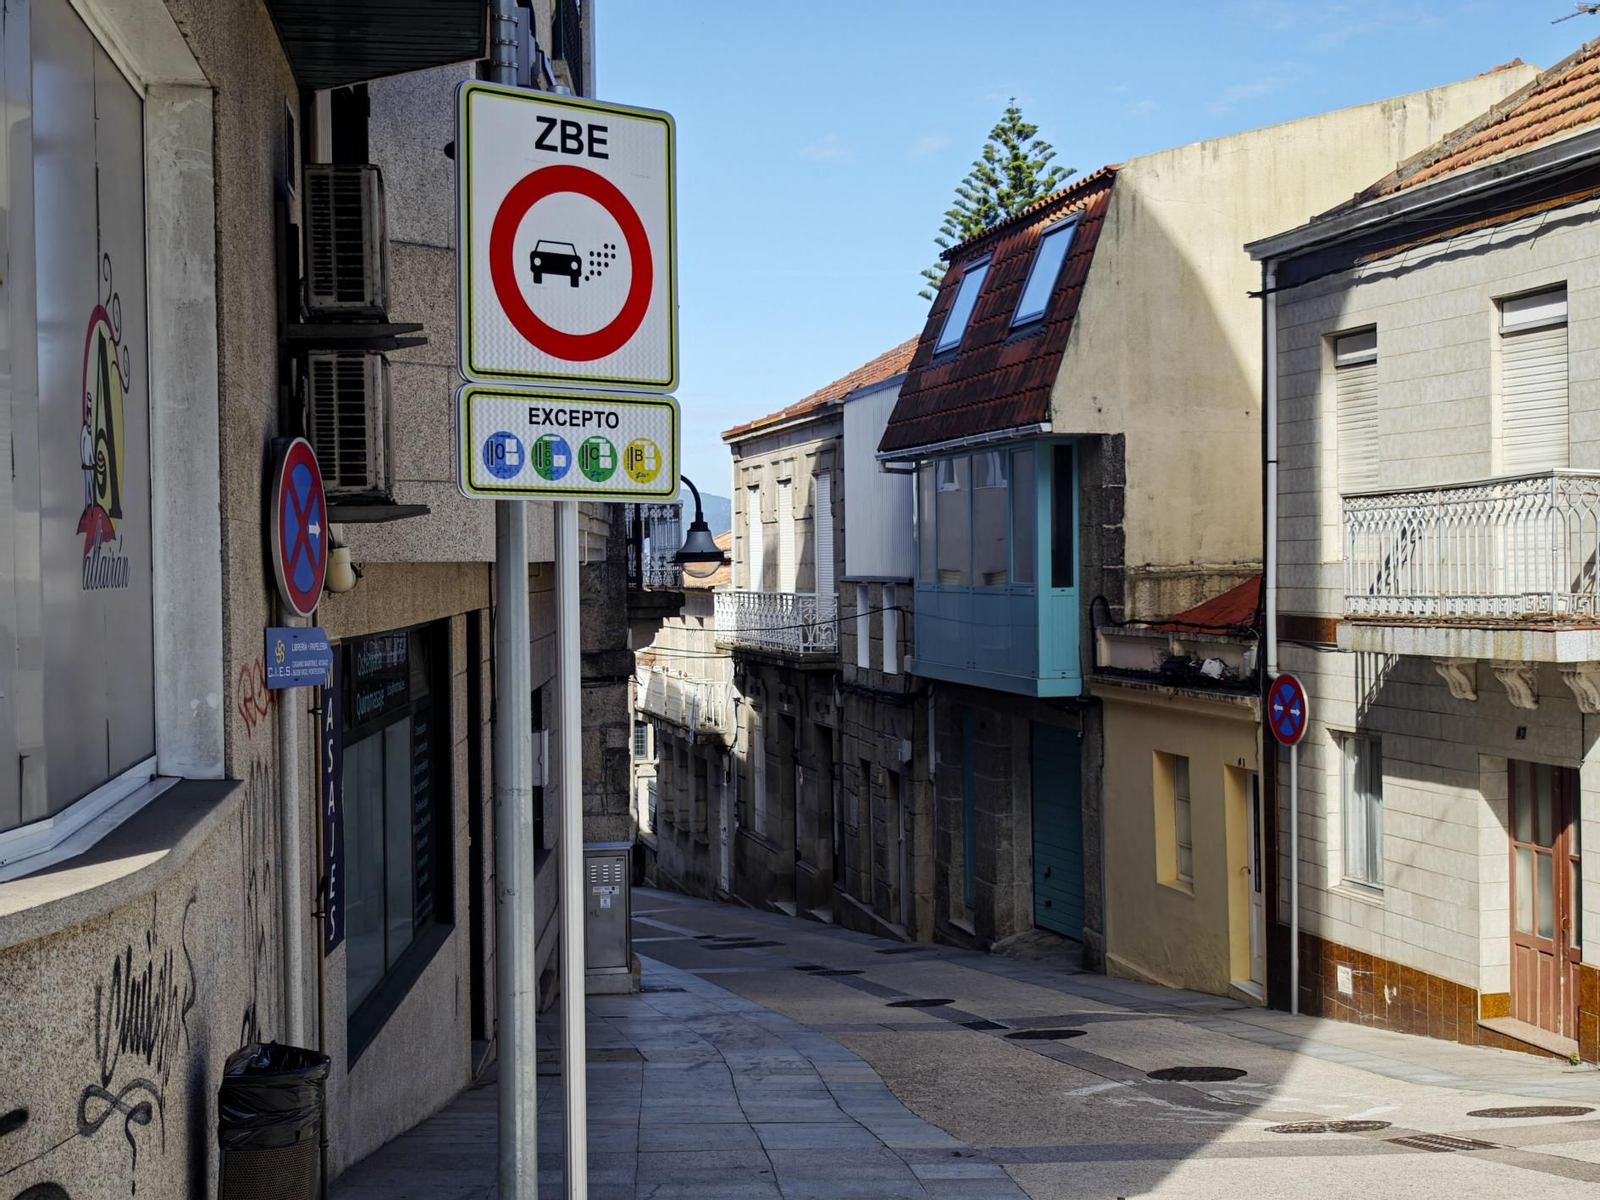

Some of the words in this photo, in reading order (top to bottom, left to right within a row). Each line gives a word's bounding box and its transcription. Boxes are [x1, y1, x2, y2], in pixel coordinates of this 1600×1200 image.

[535, 115, 609, 160] ZBE
[528, 407, 619, 429] EXCEPTO
[590, 446, 599, 461] C
[635, 449, 643, 462] B
